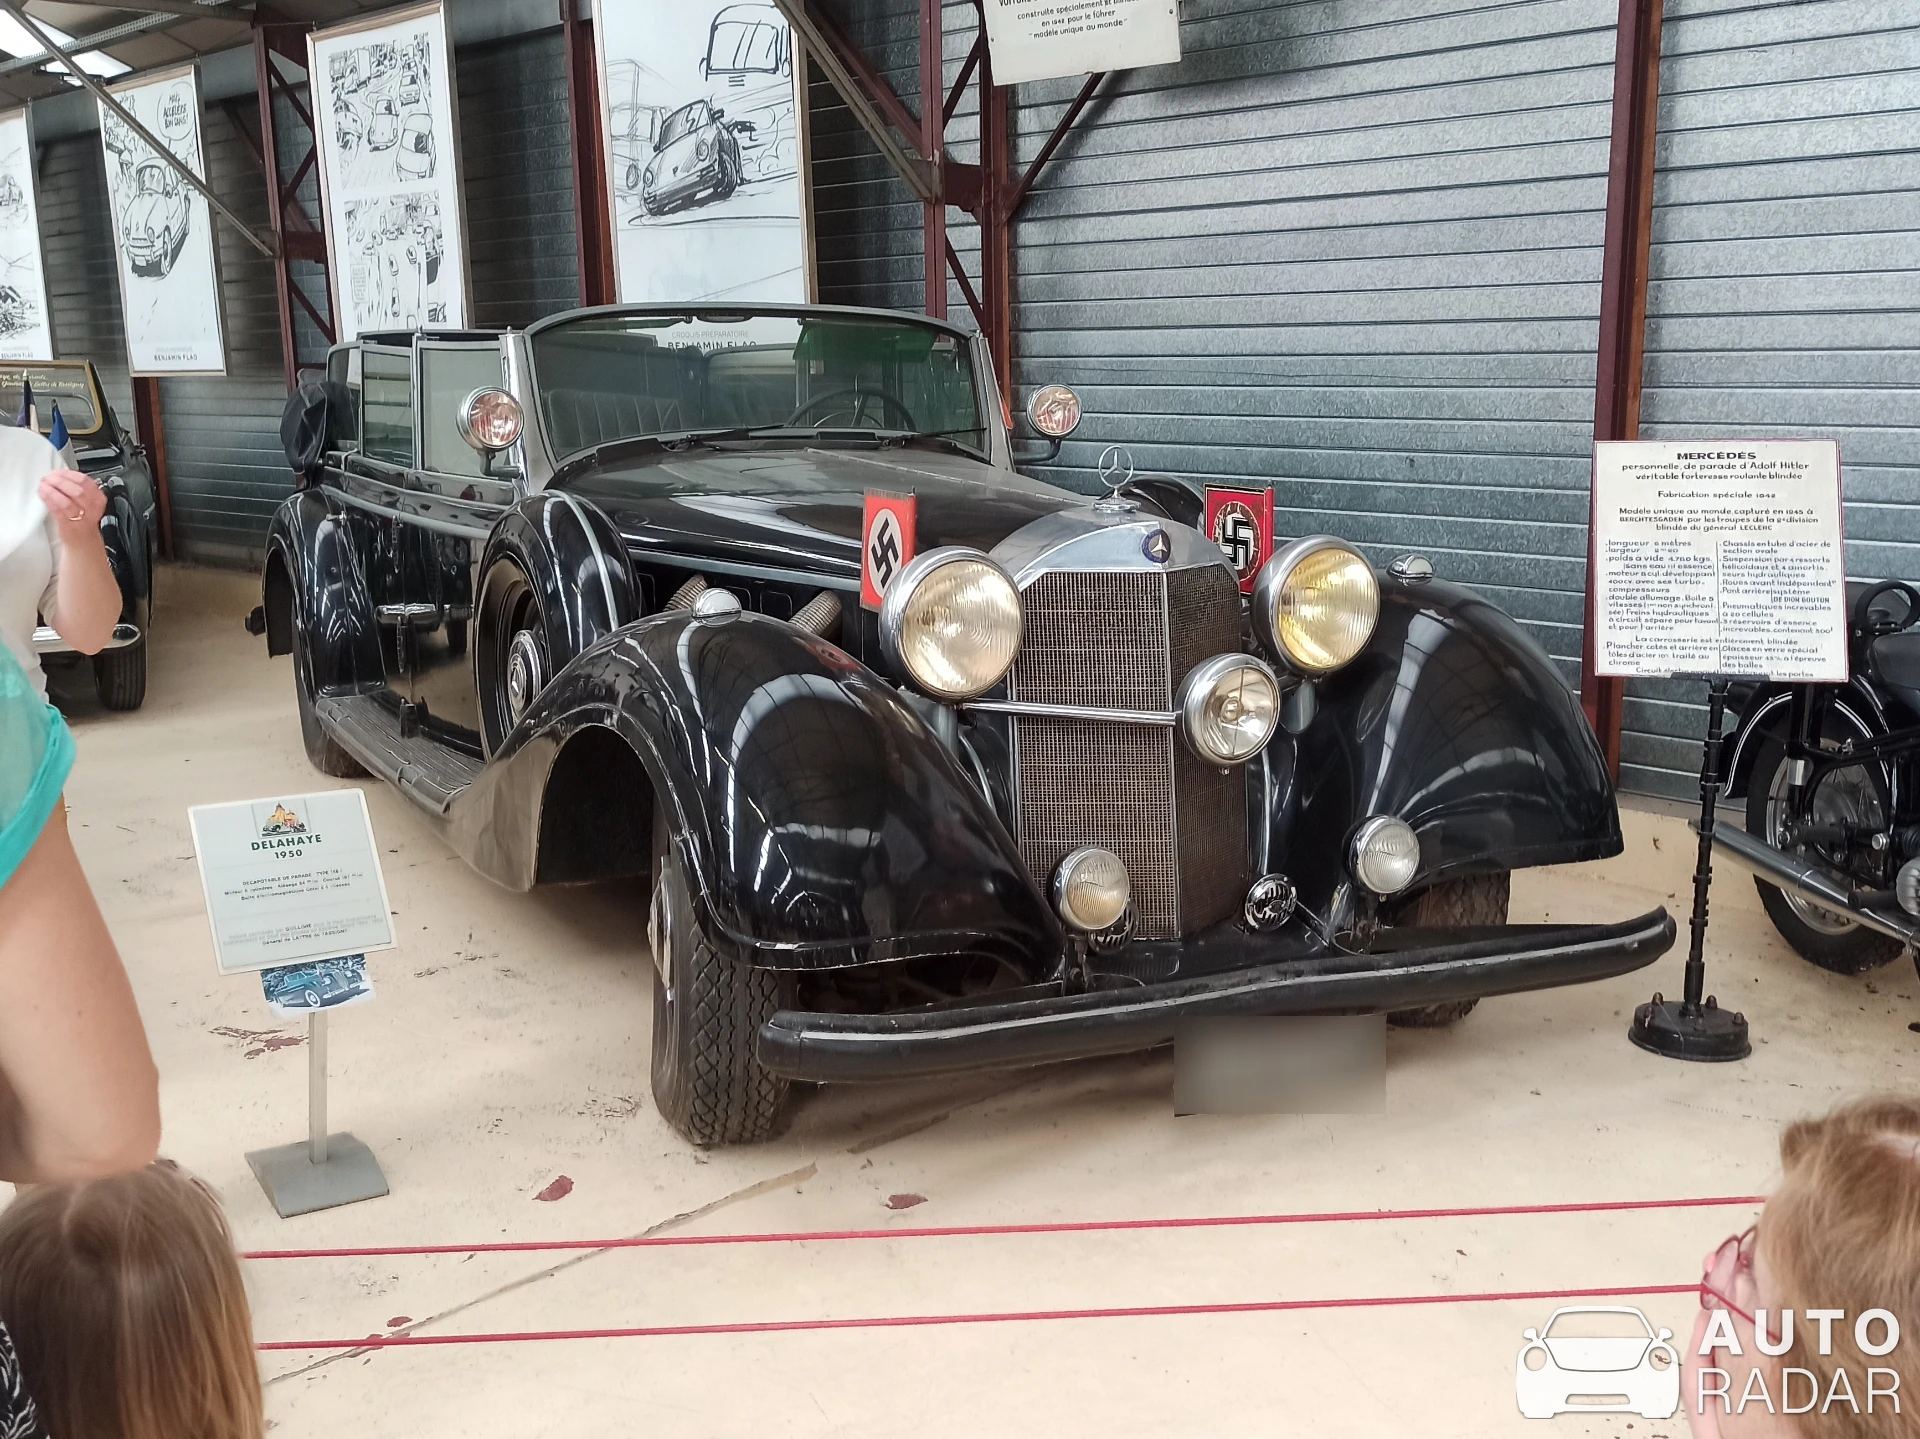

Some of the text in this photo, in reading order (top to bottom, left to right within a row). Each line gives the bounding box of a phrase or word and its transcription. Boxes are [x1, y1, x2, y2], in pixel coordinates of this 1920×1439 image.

[1017, 9, 1054, 20] construite
[1067, 15, 1083, 24] pour
[1085, 12, 1092, 20] le
[1060, 26, 1084, 35] unique
[1086, 23, 1096, 31] au
[1683, 462, 1697, 470] de
[1700, 462, 1737, 471] parade
[1739, 461, 1777, 470] d'Adolf
[1780, 461, 1810, 469] Hitler
[1636, 471, 1803, 480] véritable forteresse roulante blindée
[1658, 490, 1709, 498] Fabrication
[1713, 490, 1753, 499] spéciale
[1619, 507, 1651, 515] Modèle
[1653, 507, 1685, 515] unique
[1734, 507, 1770, 516] capturé
[1704, 515, 1716, 523] les
[1717, 515, 1751, 524] troupes
[1766, 515, 1775, 523] la
[1703, 524, 1737, 533] général
[1661, 538, 1692, 547] mètres
[1820, 540, 1831, 548] de
[1608, 554, 1634, 562] poids
[1644, 554, 1664, 562] vide
[1722, 555, 1772, 563] Suspension
[1747, 570, 1805, 579] hydrauliques
[1723, 586, 1740, 594] Pont
[1608, 593, 1638, 601] double
[1723, 602, 1783, 611] Pneumatiques
[1652, 608, 1709, 617] hydrauliques
[1742, 610, 1774, 618] cellules
[1788, 646, 1818, 654] spécial
[1672, 652, 1696, 660] traité
[1738, 661, 1763, 669] balles
[251, 834, 323, 851] DELAHAYE
[274, 849, 303, 859] 1950
